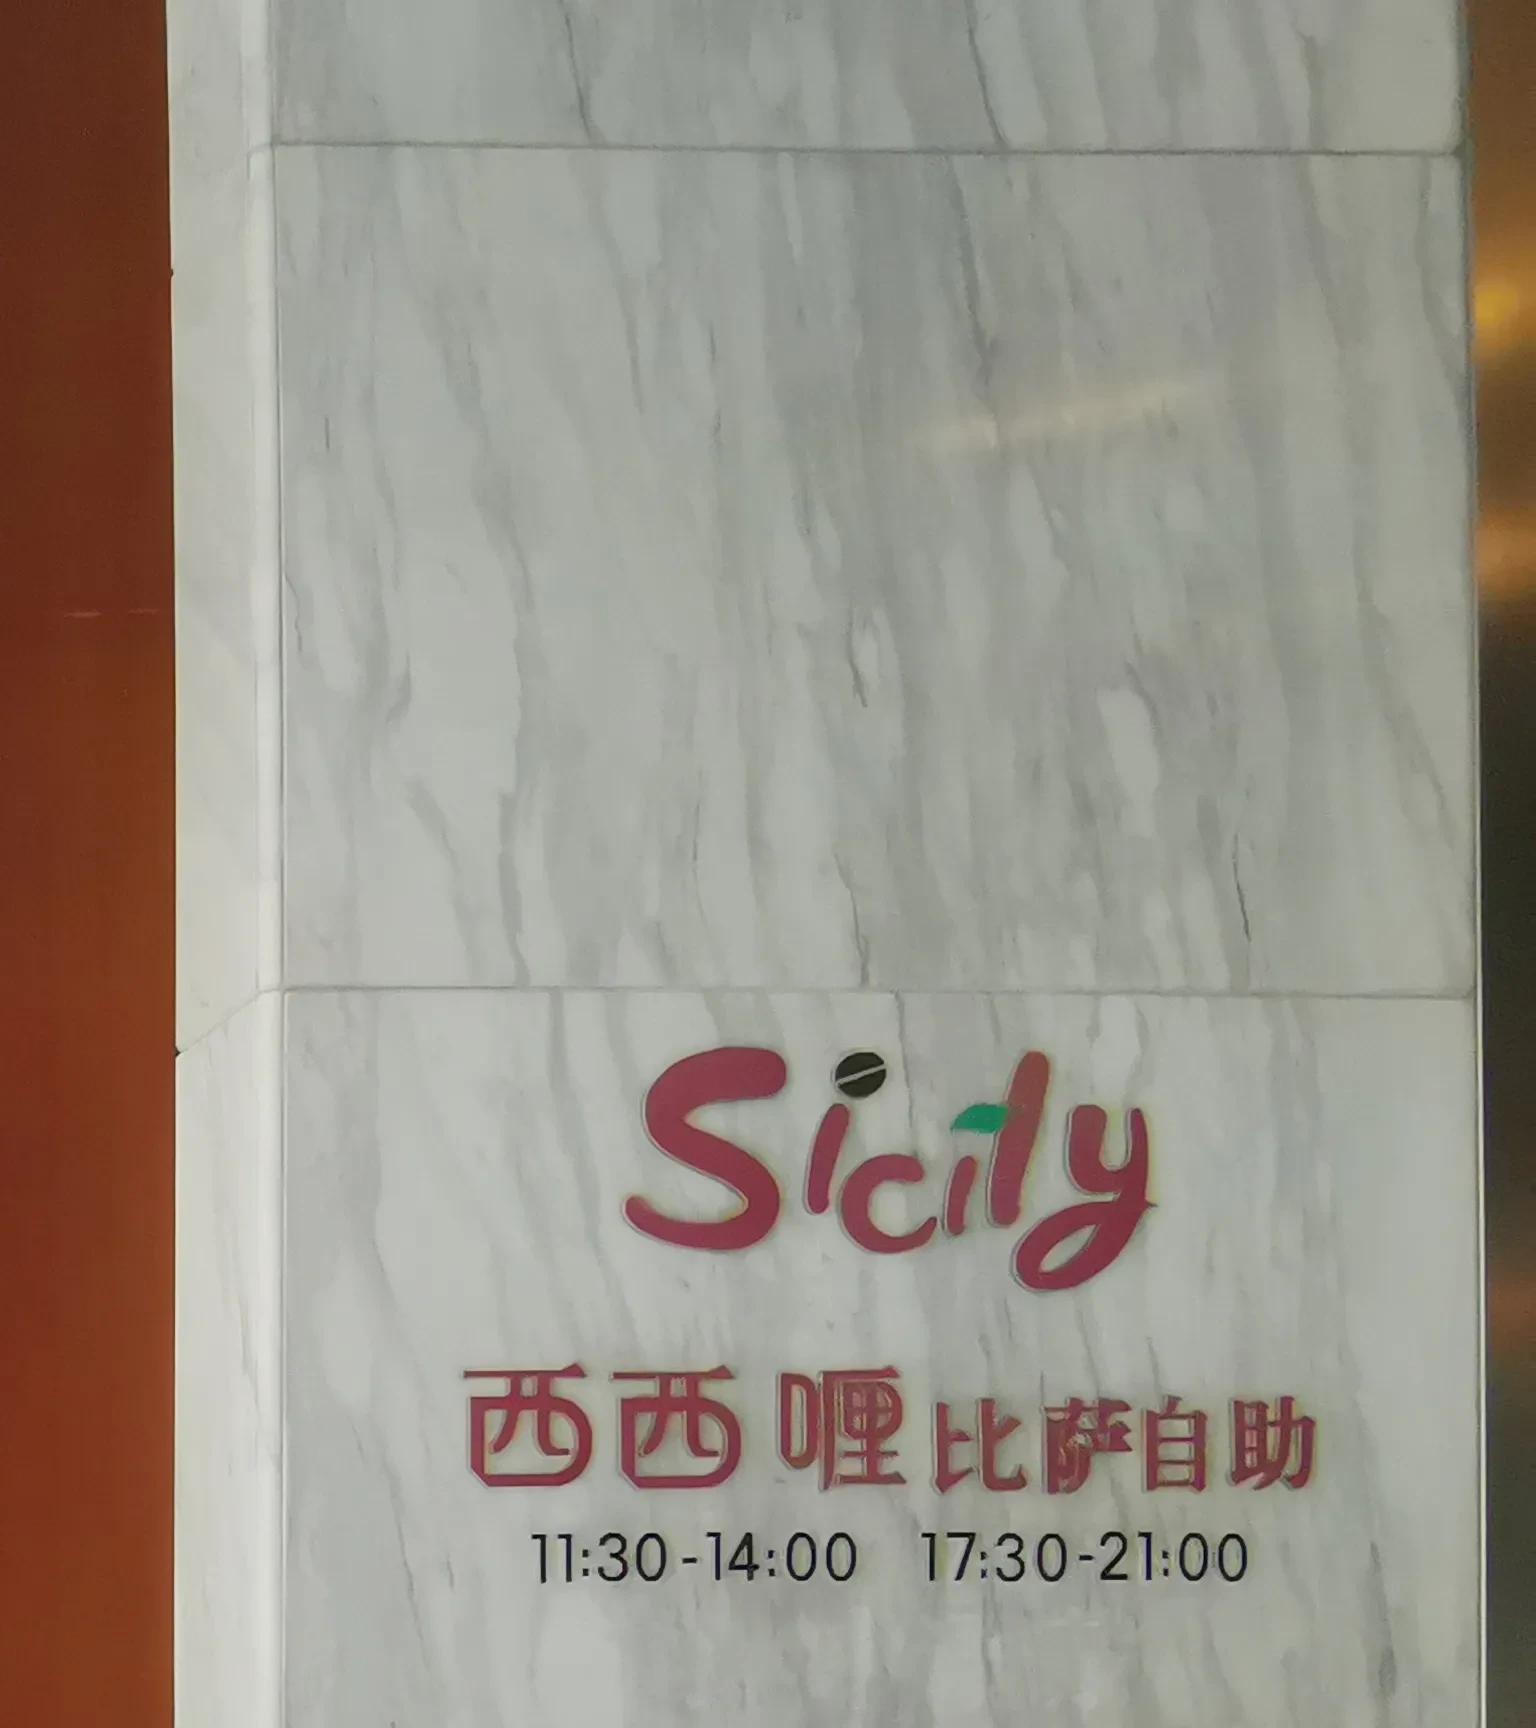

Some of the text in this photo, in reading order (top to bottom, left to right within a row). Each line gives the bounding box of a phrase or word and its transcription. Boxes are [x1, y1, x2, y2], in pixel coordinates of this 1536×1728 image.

[621, 1045, 1156, 1292] Sicily
[461, 1363, 1319, 1496] 西西喱 比萨自助
[531, 1530, 1250, 1585] 11:30-14:00 17:30-21:00
